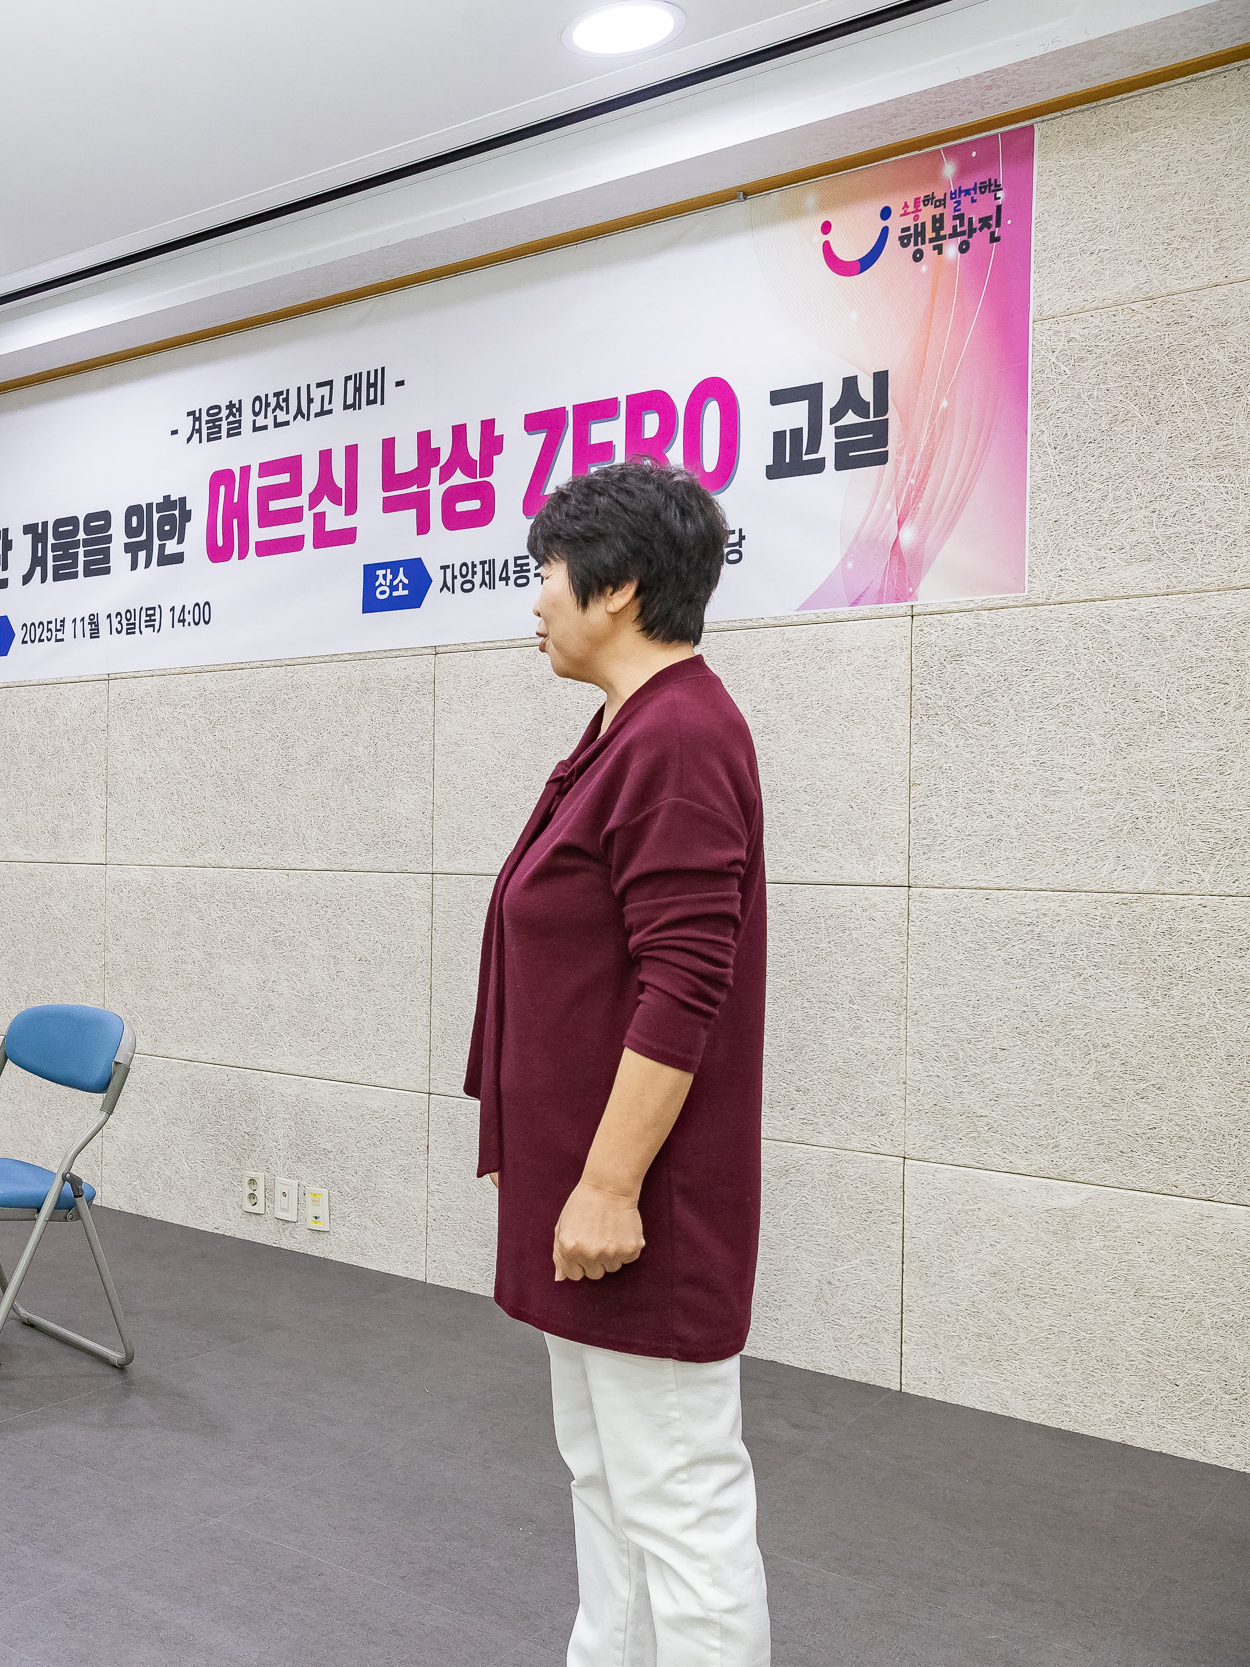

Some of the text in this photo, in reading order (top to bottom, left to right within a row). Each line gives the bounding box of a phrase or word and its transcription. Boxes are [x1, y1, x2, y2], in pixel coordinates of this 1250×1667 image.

[899, 178, 1003, 222] 소통하며 발전하는
[898, 204, 1002, 263] 행복광진
[185, 399, 243, 445] 겨울철
[251, 380, 334, 432] 안전사고
[342, 366, 386, 411] 대비
[21, 509, 112, 587] 겨울을
[123, 495, 192, 569] 위한
[206, 443, 359, 563] 어르신
[381, 417, 504, 536] 낙상
[522, 376, 740, 519] ZERO
[765, 369, 889, 481] 교실
[374, 568, 410, 599] 장소
[21, 600, 211, 645] 2025년 11월 13일(목) 14:00
